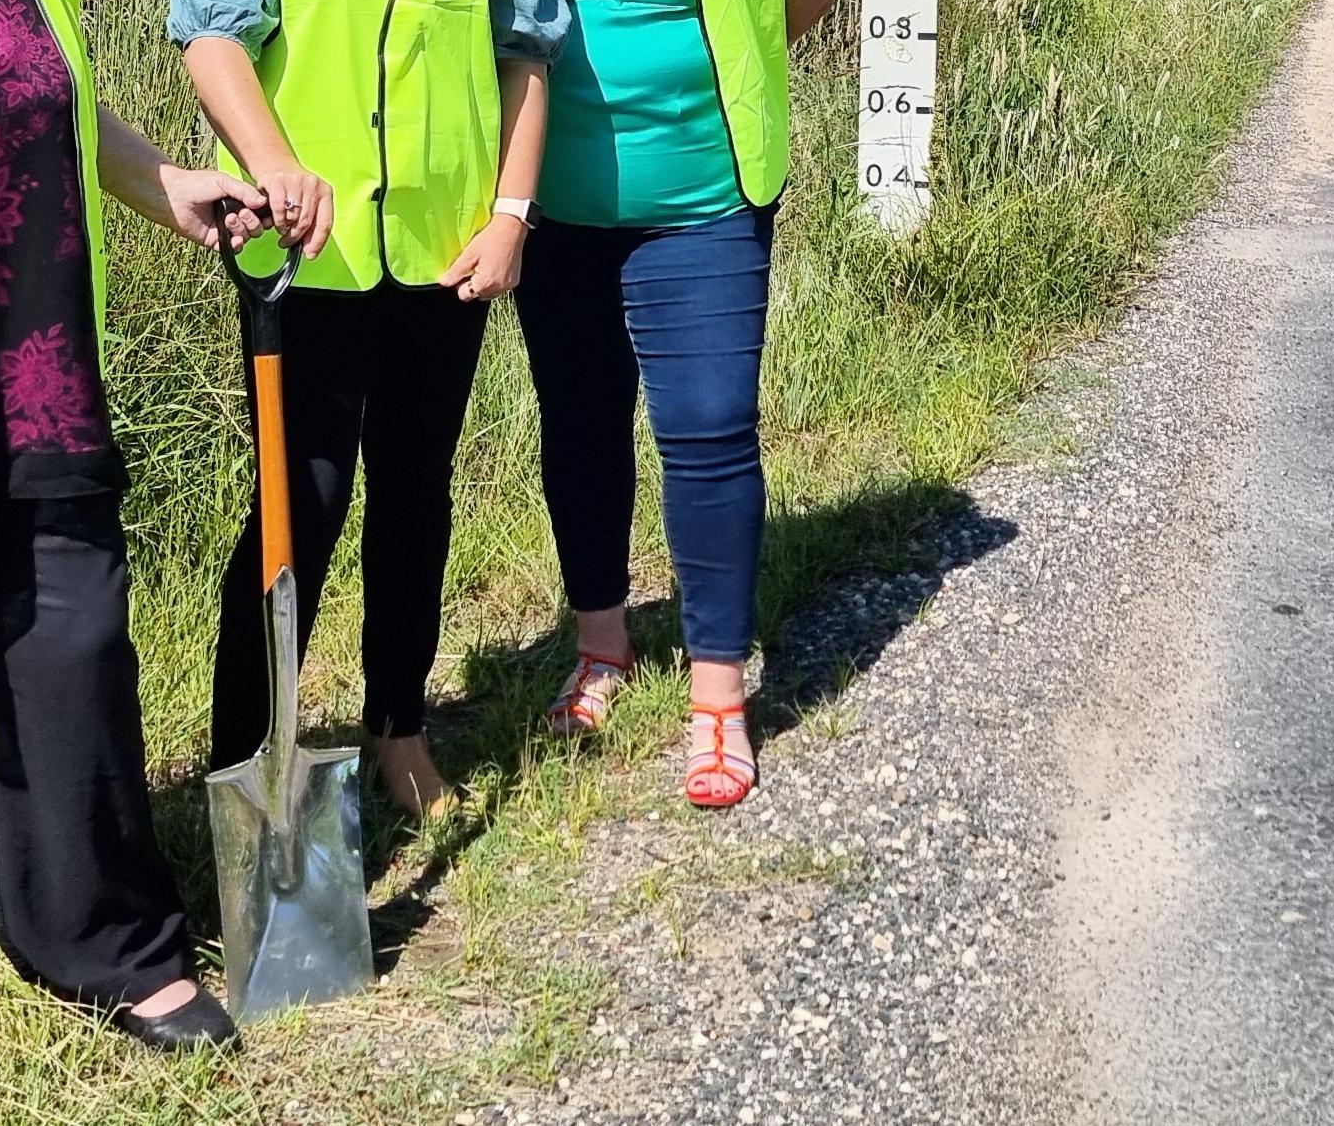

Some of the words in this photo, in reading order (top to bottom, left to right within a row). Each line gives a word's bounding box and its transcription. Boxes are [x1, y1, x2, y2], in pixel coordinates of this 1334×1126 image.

[869, 15, 912, 40] 08
[867, 89, 911, 114] 0.6
[866, 163, 912, 188] 0.4
